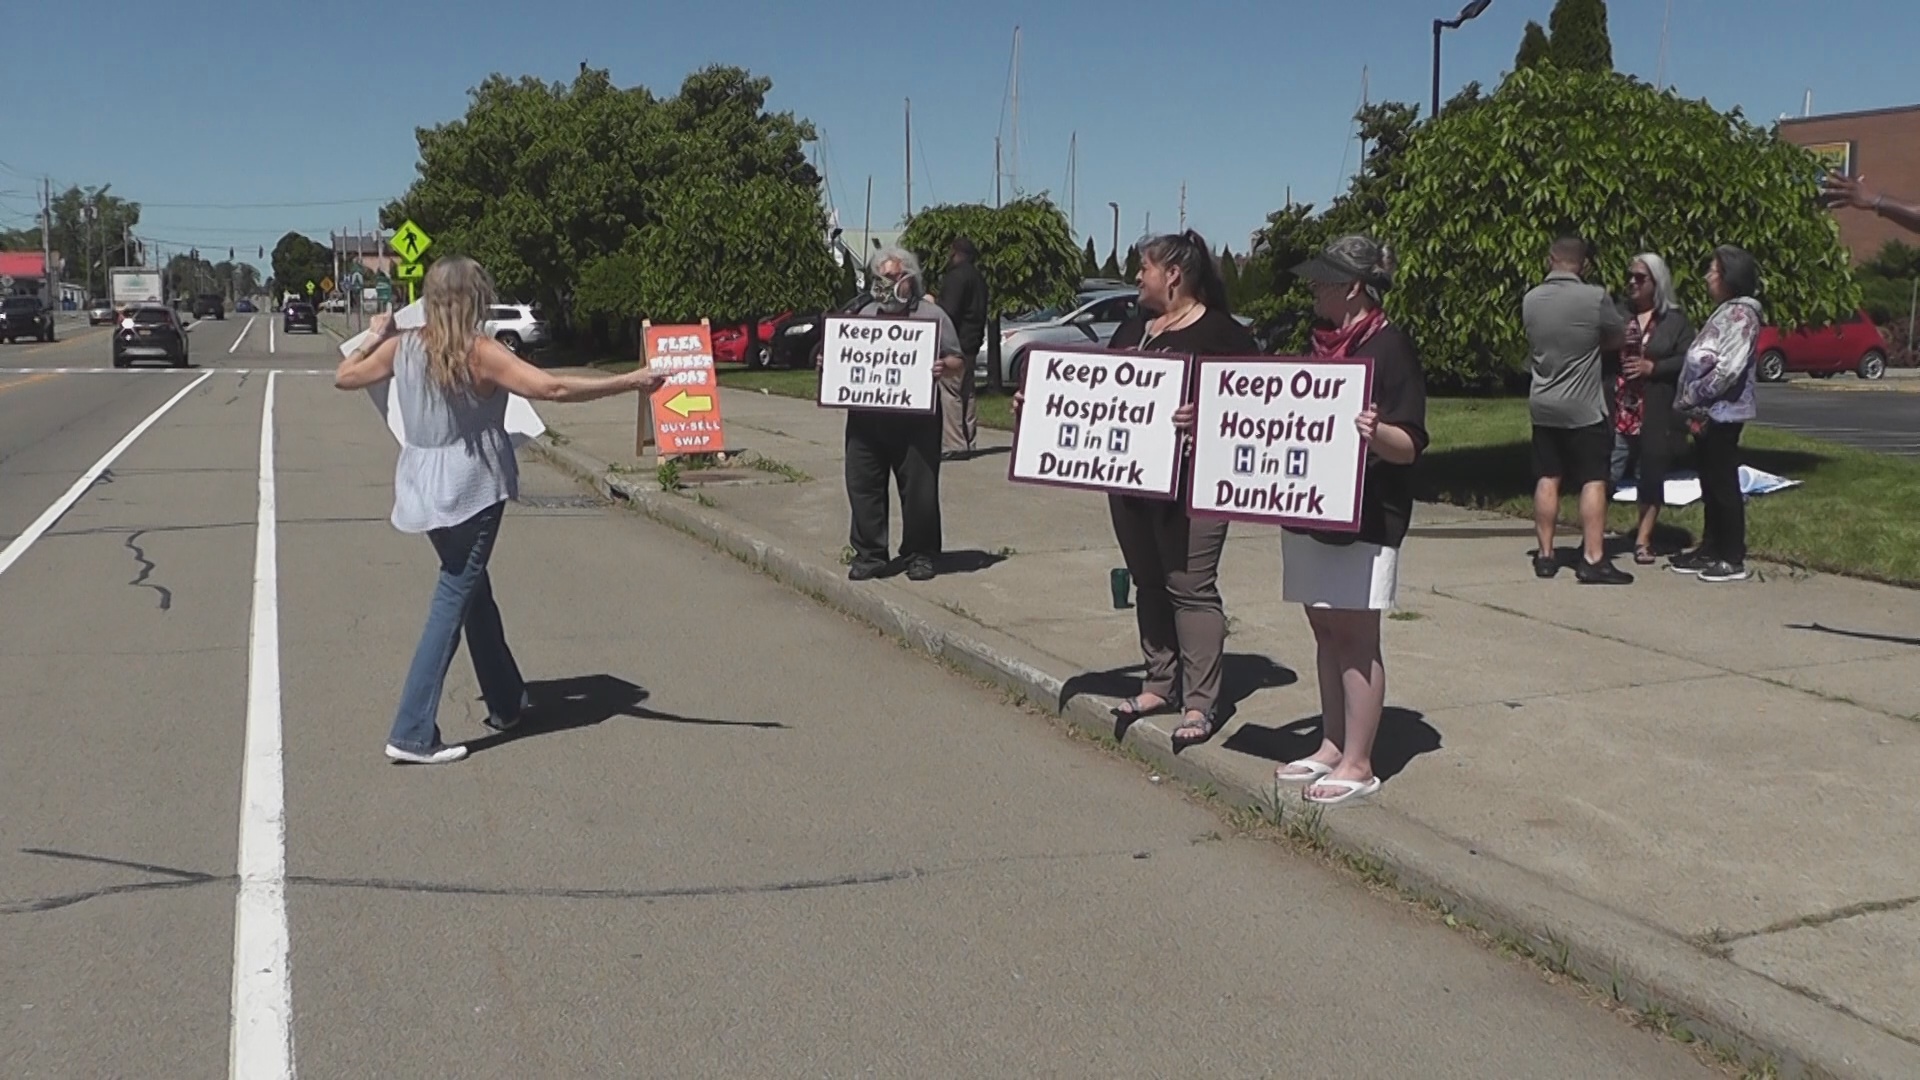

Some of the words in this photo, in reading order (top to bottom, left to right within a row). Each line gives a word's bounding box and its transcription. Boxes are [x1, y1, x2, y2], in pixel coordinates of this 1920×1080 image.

[657, 334, 703, 353] FLEA
[838, 322, 883, 344] Keep
[887, 324, 924, 342] Our
[650, 354, 713, 370] MARKET
[840, 346, 918, 368] Hospital
[668, 370, 708, 386] ODAY
[868, 371, 882, 384] in
[1045, 357, 1108, 390] Keep
[1114, 361, 1166, 389] Our
[837, 386, 912, 406] Dunkirk
[1218, 369, 1283, 405] Keep
[1290, 369, 1347, 399] Our
[1045, 393, 1156, 426] Hospital
[660, 420, 721, 433] BUY-SELL
[1219, 410, 1336, 447] Hospital
[674, 435, 711, 448] SWAP
[1059, 425, 1078, 448] H
[1083, 431, 1102, 450] in
[1109, 430, 1129, 452] H
[1038, 452, 1145, 486] Dunkirk
[1234, 447, 1254, 474] H
[1260, 453, 1280, 475] in
[1286, 450, 1307, 476] H
[1215, 479, 1326, 516] Dunkirk
